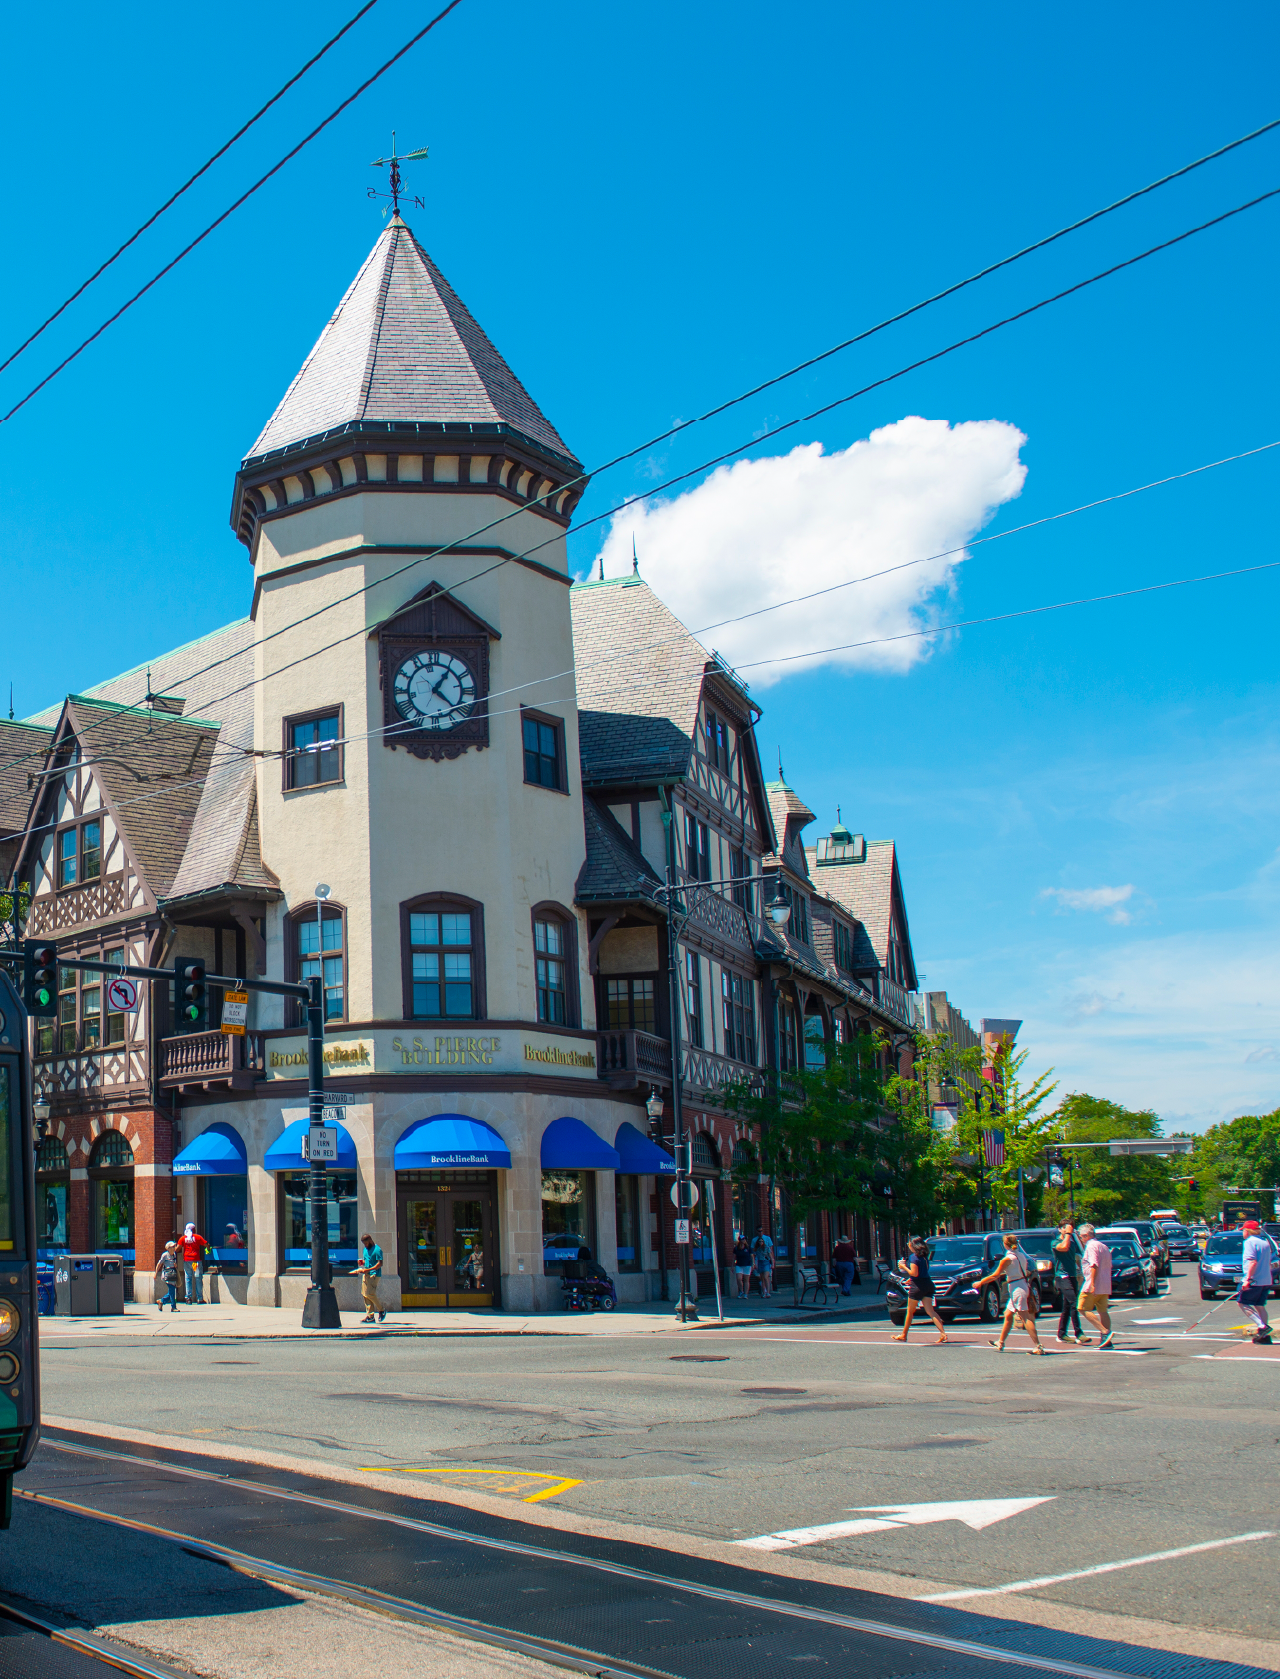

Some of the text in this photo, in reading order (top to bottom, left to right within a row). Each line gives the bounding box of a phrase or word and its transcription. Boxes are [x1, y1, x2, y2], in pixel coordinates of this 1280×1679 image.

[392, 1036, 502, 1051] S. S. PIERCE
[401, 1051, 494, 1065] BUILDING
[524, 1044, 597, 1068] BrooklineBank
[431, 1155, 489, 1163] BrooklineBank
